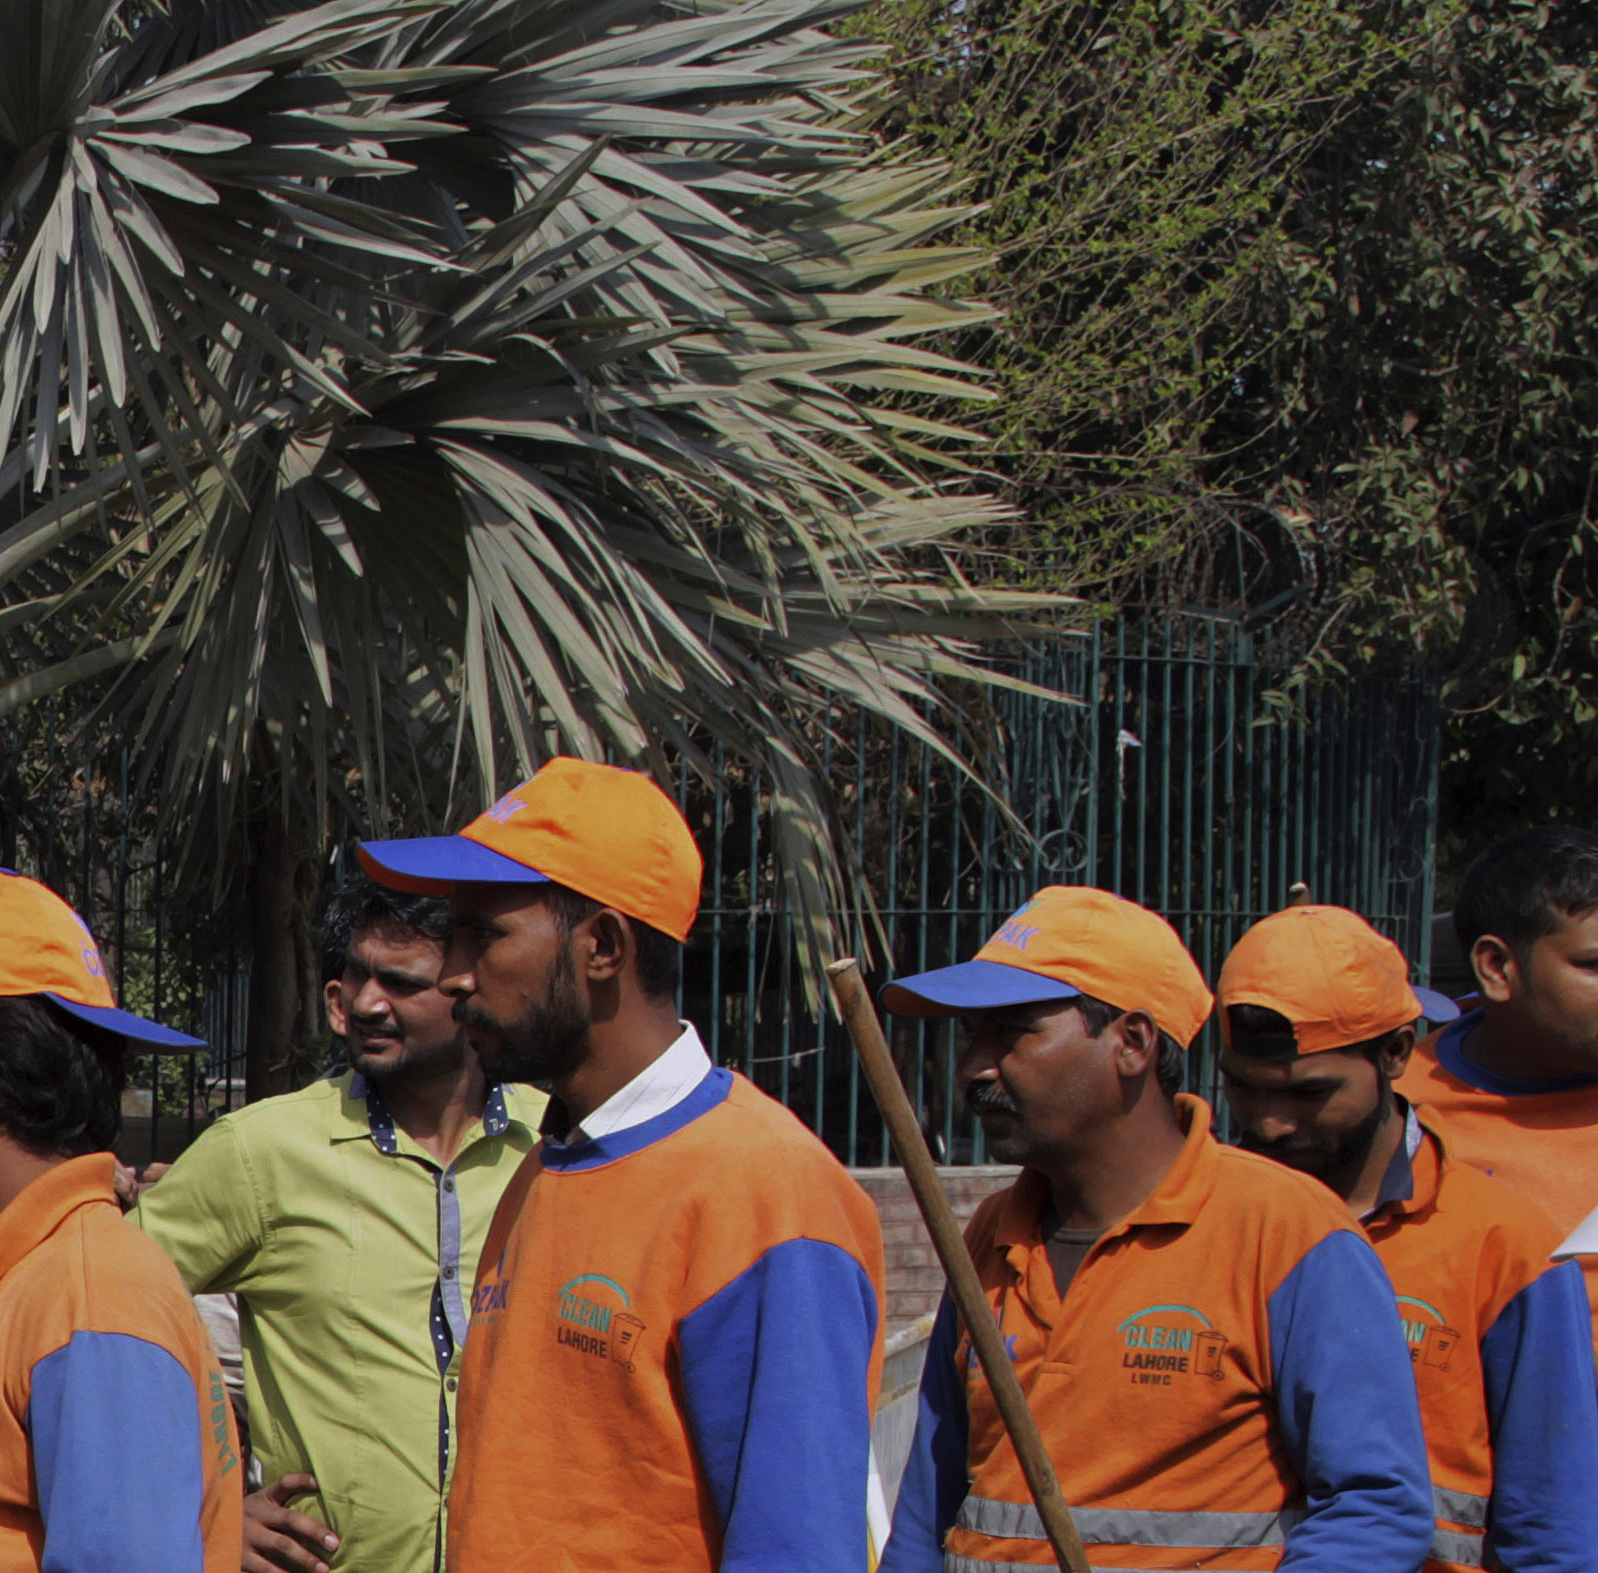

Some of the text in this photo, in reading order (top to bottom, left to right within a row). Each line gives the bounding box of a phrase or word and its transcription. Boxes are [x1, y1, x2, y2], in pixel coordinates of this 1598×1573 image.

[560, 1293, 613, 1333] CLEAN
[557, 1326, 608, 1359] LAHORE
[1125, 1324, 1194, 1352] CLEAN
[1122, 1352, 1189, 1373] LAHORE
[1131, 1373, 1172, 1386] LWMC
